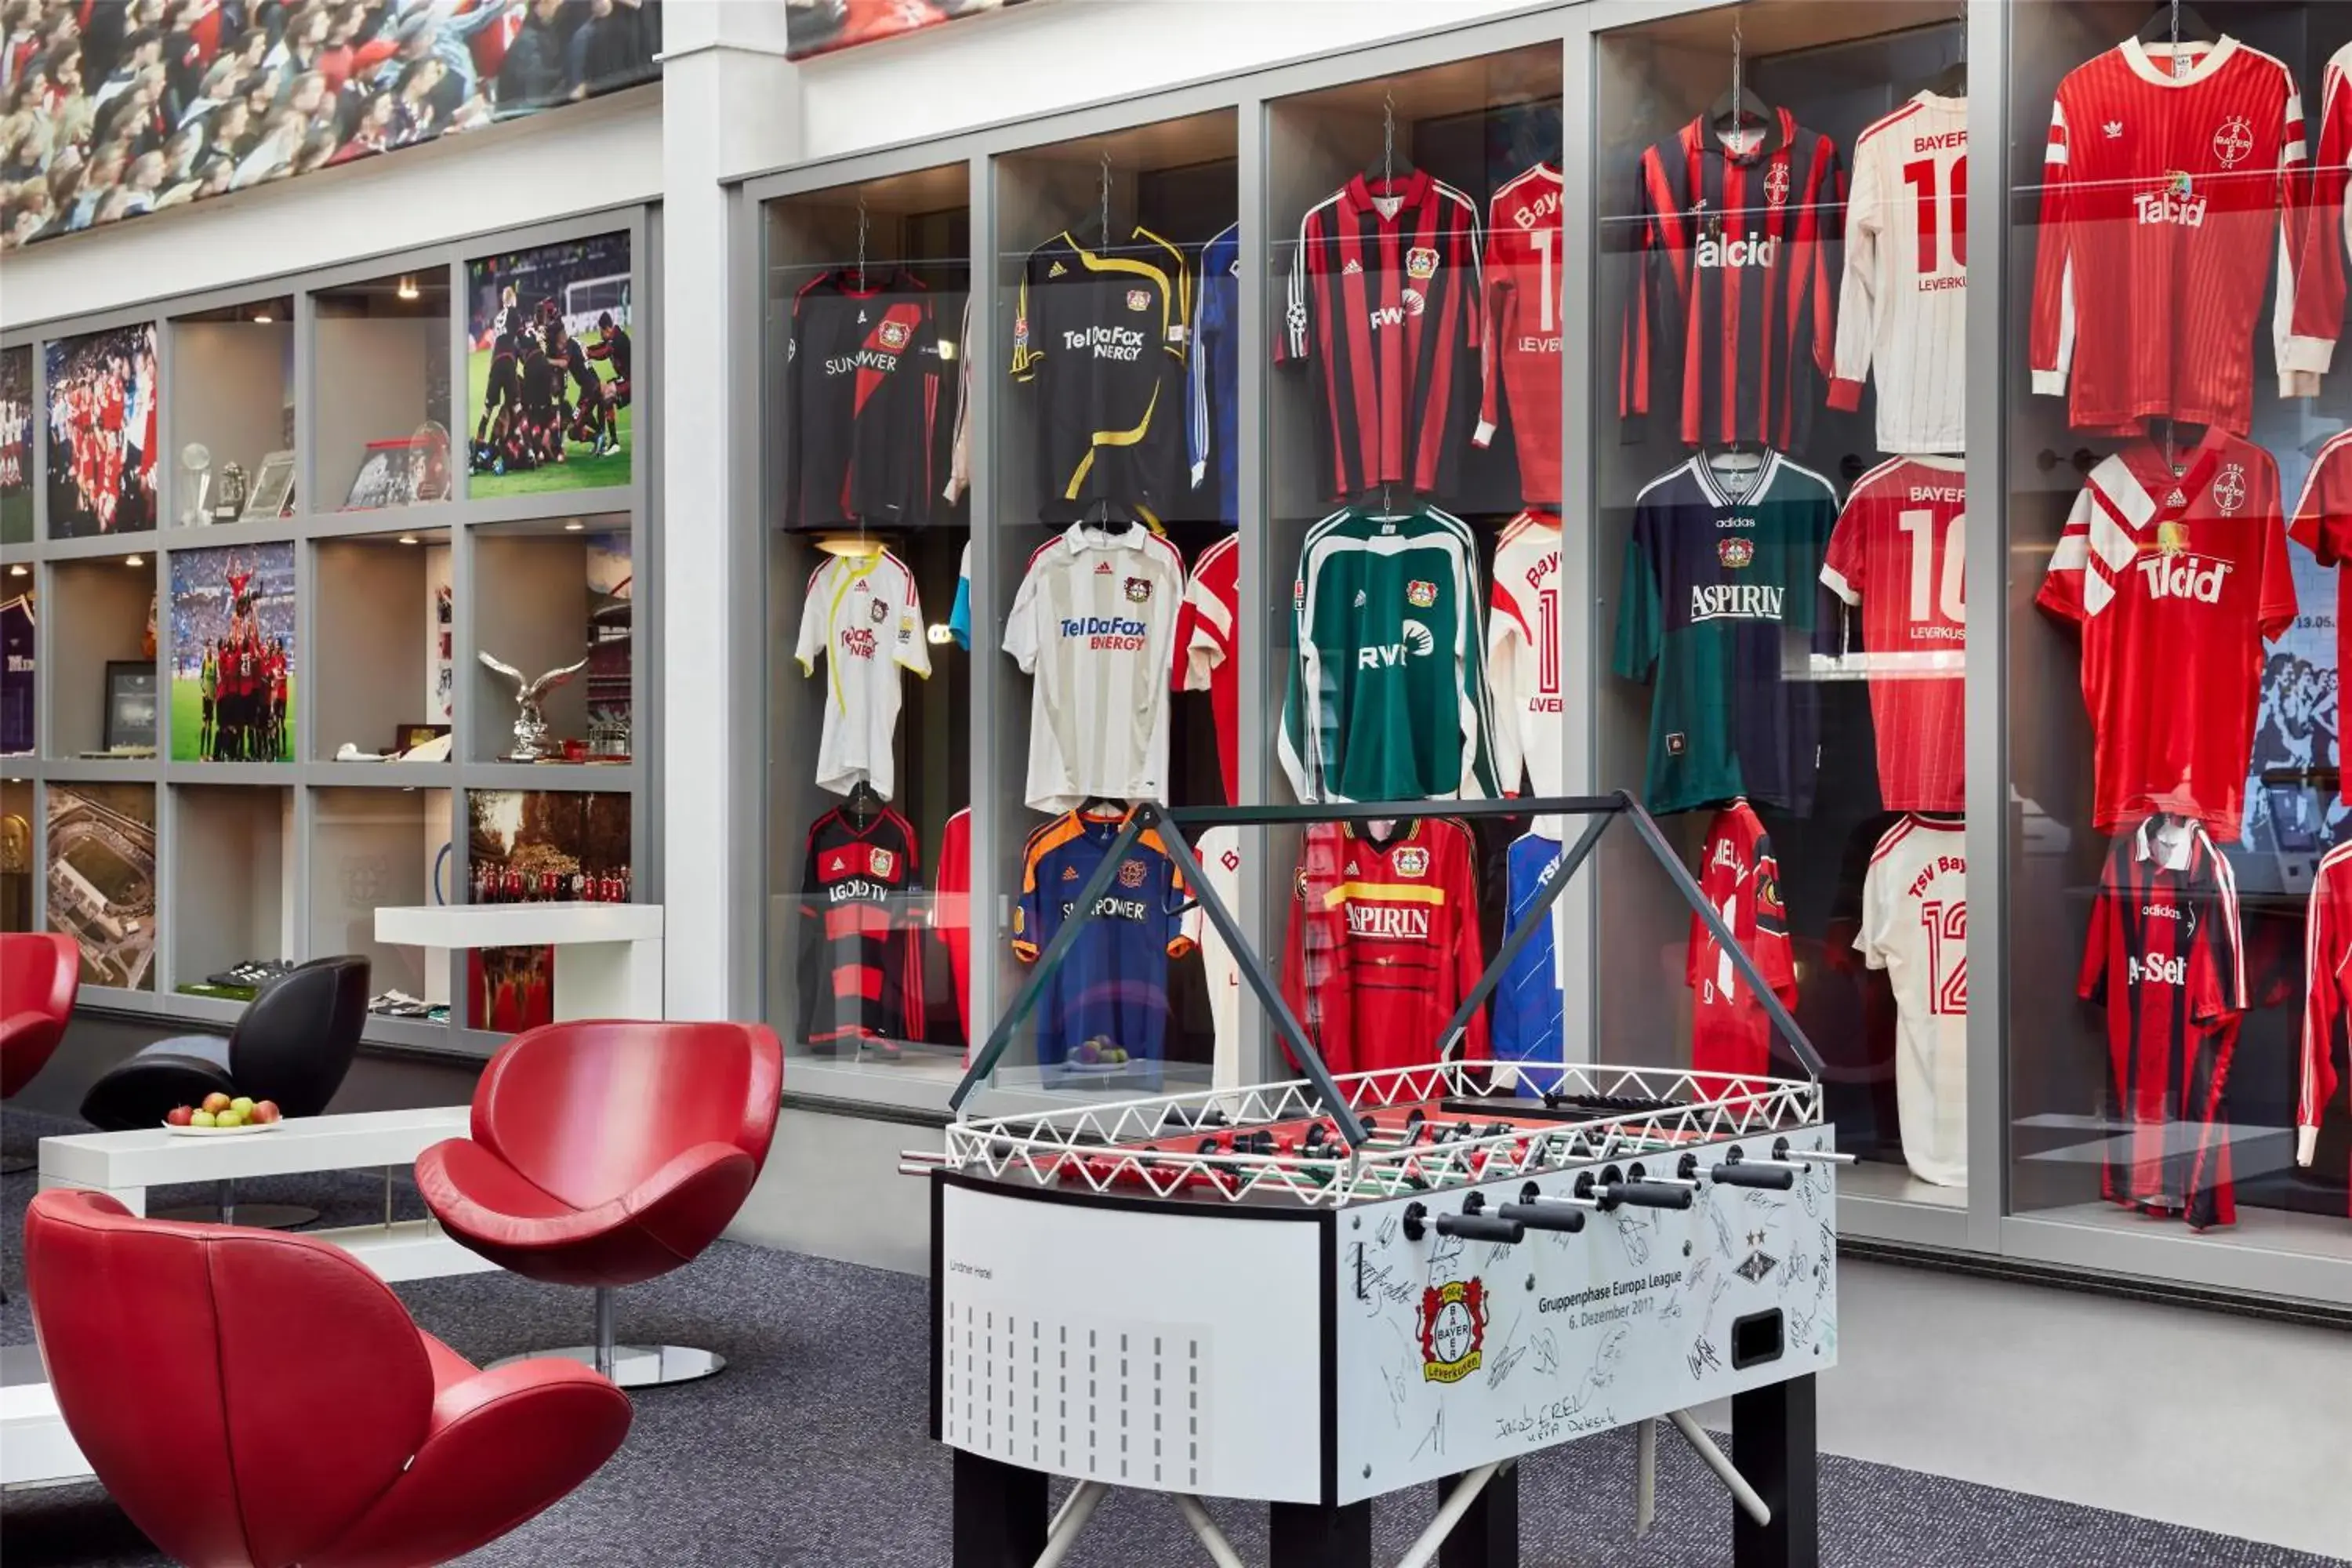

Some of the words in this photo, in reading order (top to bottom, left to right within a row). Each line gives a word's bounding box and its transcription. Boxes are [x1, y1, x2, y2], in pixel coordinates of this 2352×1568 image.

[1514, 191, 1564, 229] Bay
[1094, 343, 1142, 361] NERGY
[1519, 336, 1563, 352] LEVE
[1715, 517, 1756, 528] adidas
[1526, 551, 1563, 590] Bay
[1690, 584, 1785, 622] ASPIRIN
[1908, 863, 1935, 898] TSV
[1539, 1285, 1611, 1314] Gruppenphase
[1613, 1279, 1646, 1297] Europa
[1649, 1271, 1682, 1288] League
[1569, 1314, 1579, 1330] 6.
[1581, 1305, 1630, 1327] Dezember
[1632, 1296, 1654, 1316] 2017
[1437, 1324, 1468, 1340] BAYER
[1428, 1357, 1478, 1380] Leverkusen
